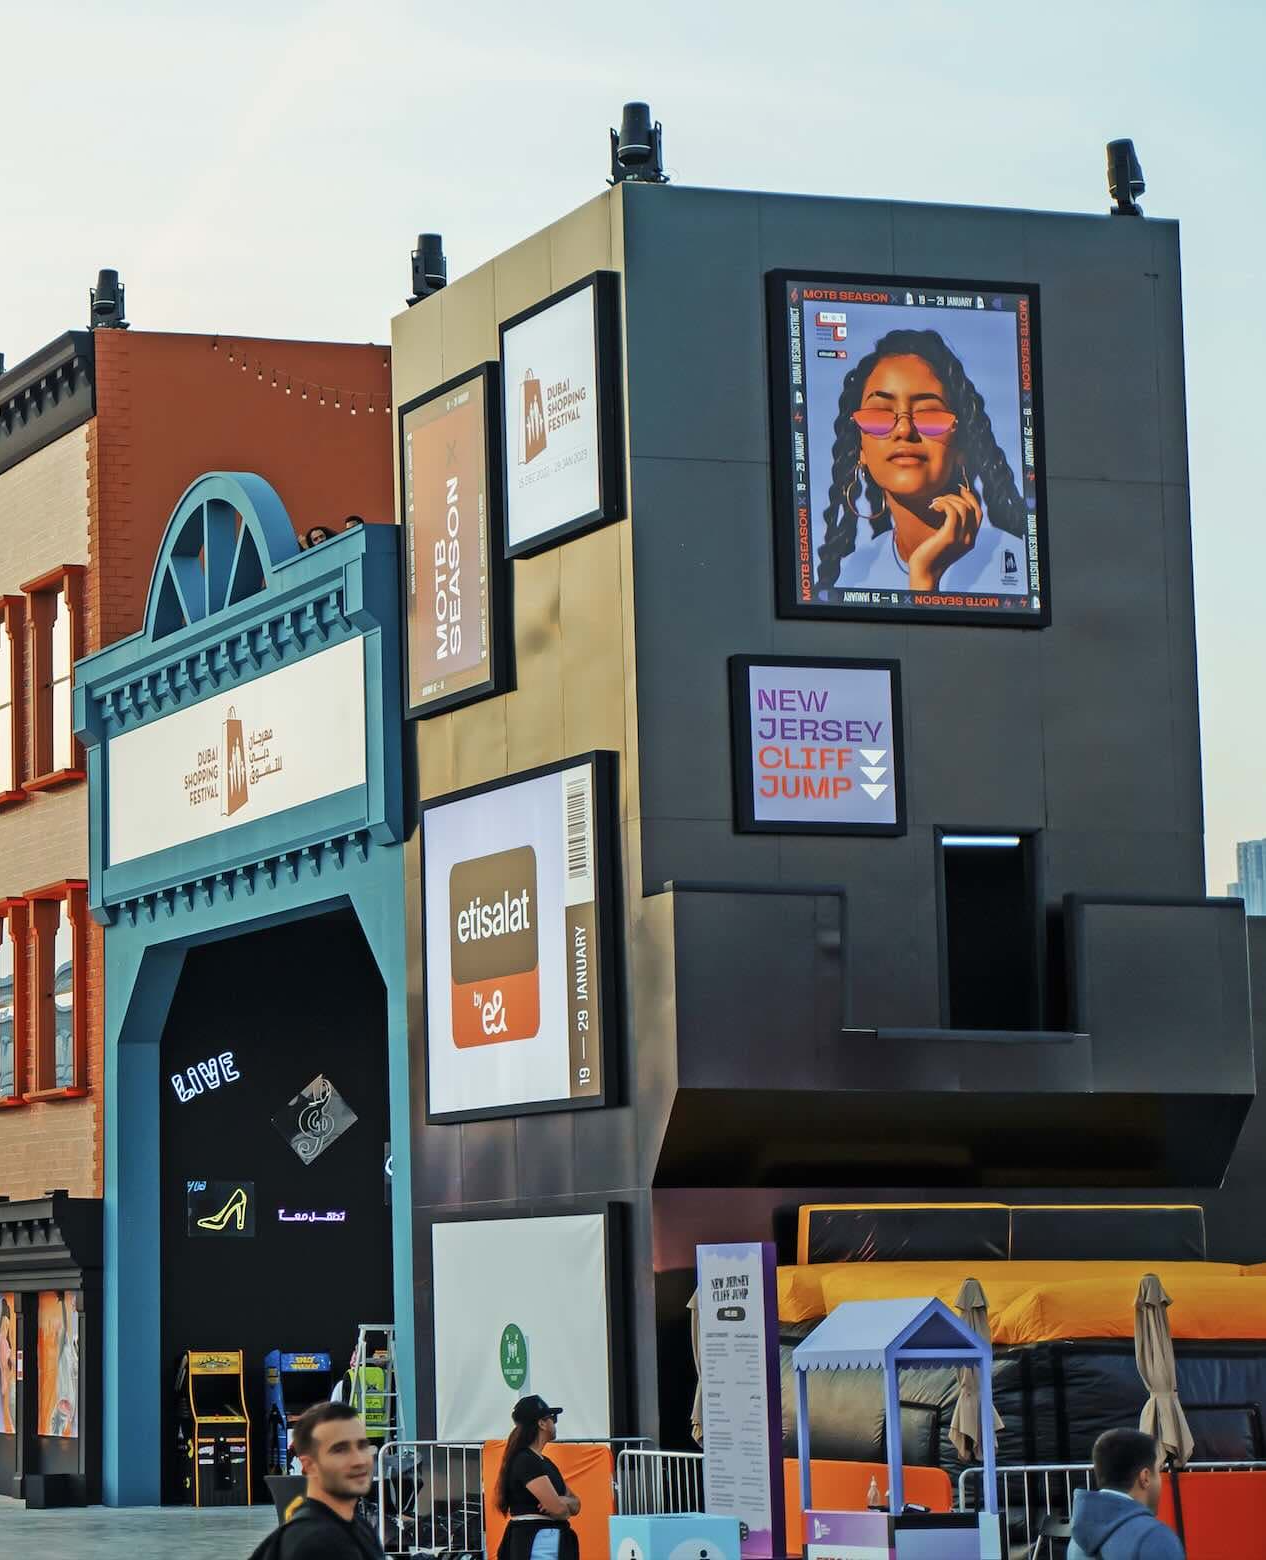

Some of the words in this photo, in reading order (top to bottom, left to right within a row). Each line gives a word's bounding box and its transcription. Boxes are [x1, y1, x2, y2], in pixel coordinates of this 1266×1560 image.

[803, 289, 837, 300] MOTB
[838, 291, 888, 303] SEASON
[918, 295, 926, 304] 19
[946, 296, 973, 308] JANUARY
[790, 307, 800, 337] DISTRICT
[1019, 300, 1030, 337] MOTB
[791, 338, 802, 363] DESIGN
[792, 364, 803, 384] DUBAI
[1021, 338, 1032, 391] SEASON
[547, 377, 570, 401] DUBAI
[547, 387, 587, 417] SHOPPING
[548, 407, 580, 432] FESTIVAL
[795, 432, 806, 461] JANUARY
[1024, 437, 1035, 467] JANUARY
[799, 509, 810, 562] SEASON
[446, 476, 462, 656] SEASON
[801, 563, 812, 601] MOTB
[435, 538, 448, 660] MOTB
[843, 591, 870, 602] JANUARY
[914, 596, 963, 607] SEASON
[965, 598, 999, 608] MOTB
[758, 689, 828, 712] NEW
[758, 718, 883, 743] JERSEY
[198, 745, 218, 767] DUBAI
[758, 745, 853, 770] CLIFF
[184, 764, 218, 790] SHOPPING
[759, 775, 853, 800] JUMP
[190, 783, 219, 806] FESTIVAL
[457, 889, 530, 944] etisalat
[575, 926, 587, 1001] JANUARY
[473, 991, 483, 1009] by
[577, 1010, 589, 1031] 29
[171, 1051, 240, 1102] LIVE
[580, 1067, 591, 1087] 19
[711, 1277, 724, 1290] NEW
[726, 1274, 749, 1287] JERSEY
[712, 1290, 730, 1302] CLIFF
[732, 1288, 749, 1300] JUMP
